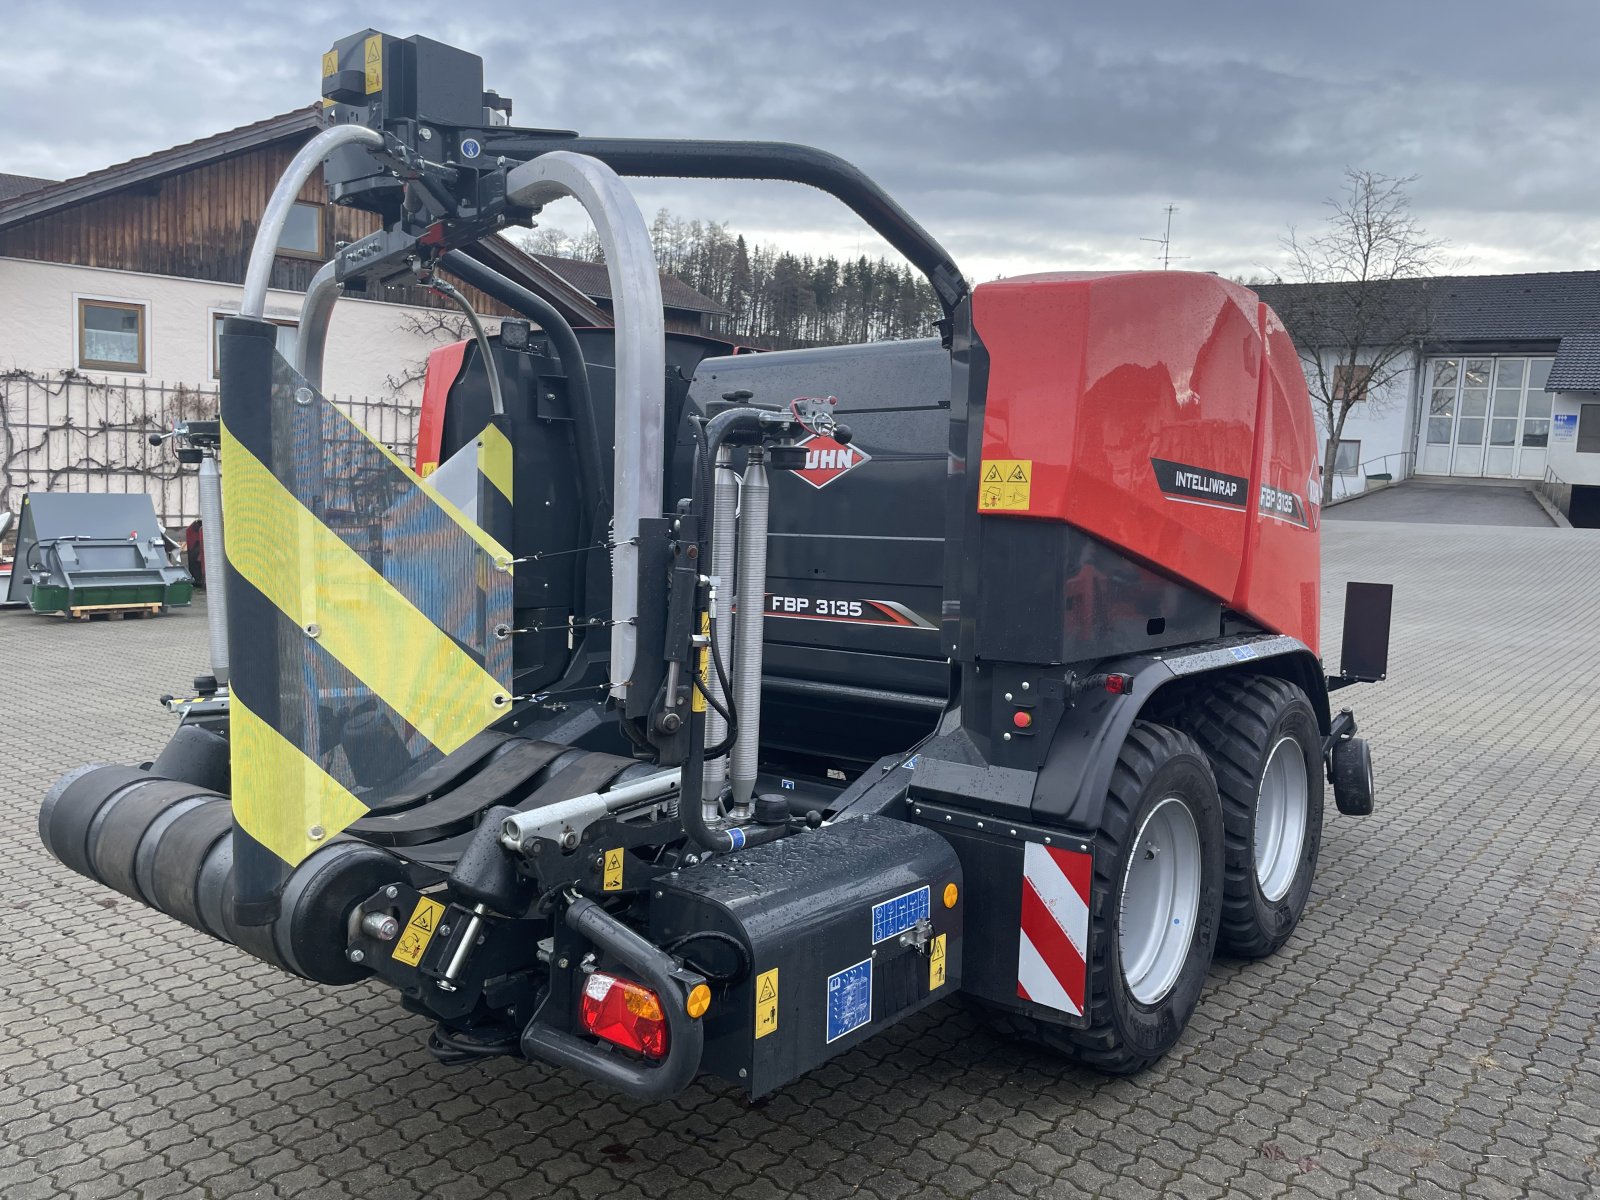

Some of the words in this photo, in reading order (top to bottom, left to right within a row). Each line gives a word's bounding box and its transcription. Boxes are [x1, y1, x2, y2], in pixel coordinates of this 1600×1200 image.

[805, 449, 854, 470] UHN
[1175, 470, 1238, 497] INTELLIWRAP
[1260, 487, 1276, 507] FBP
[1276, 492, 1293, 514] 3135
[772, 596, 809, 612] FBP
[816, 599, 863, 618] 3135
